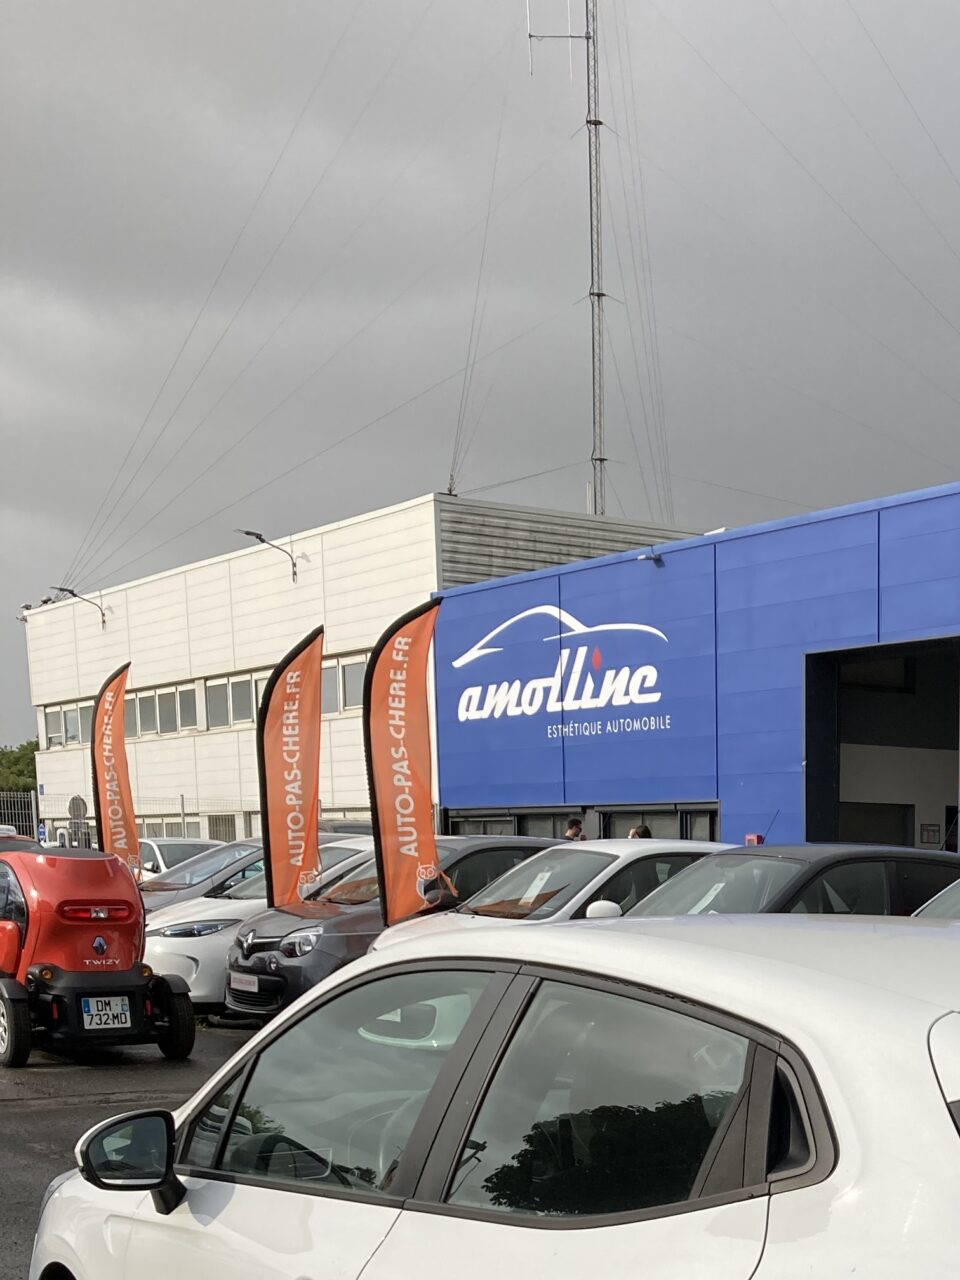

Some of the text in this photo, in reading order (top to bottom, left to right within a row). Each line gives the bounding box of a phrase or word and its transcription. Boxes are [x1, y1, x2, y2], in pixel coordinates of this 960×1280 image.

[103, 691, 128, 849] AUTO-PAS-CHERE.FR
[282, 670, 305, 866] AUTO-PAS-CHERE.FR
[389, 636, 418, 857] AUTO-PAS-CHERE.FR
[547, 715, 671, 738] ESTHÉTIQUE AUTOMOBILE
[86, 1012, 128, 1026] 732-MD
